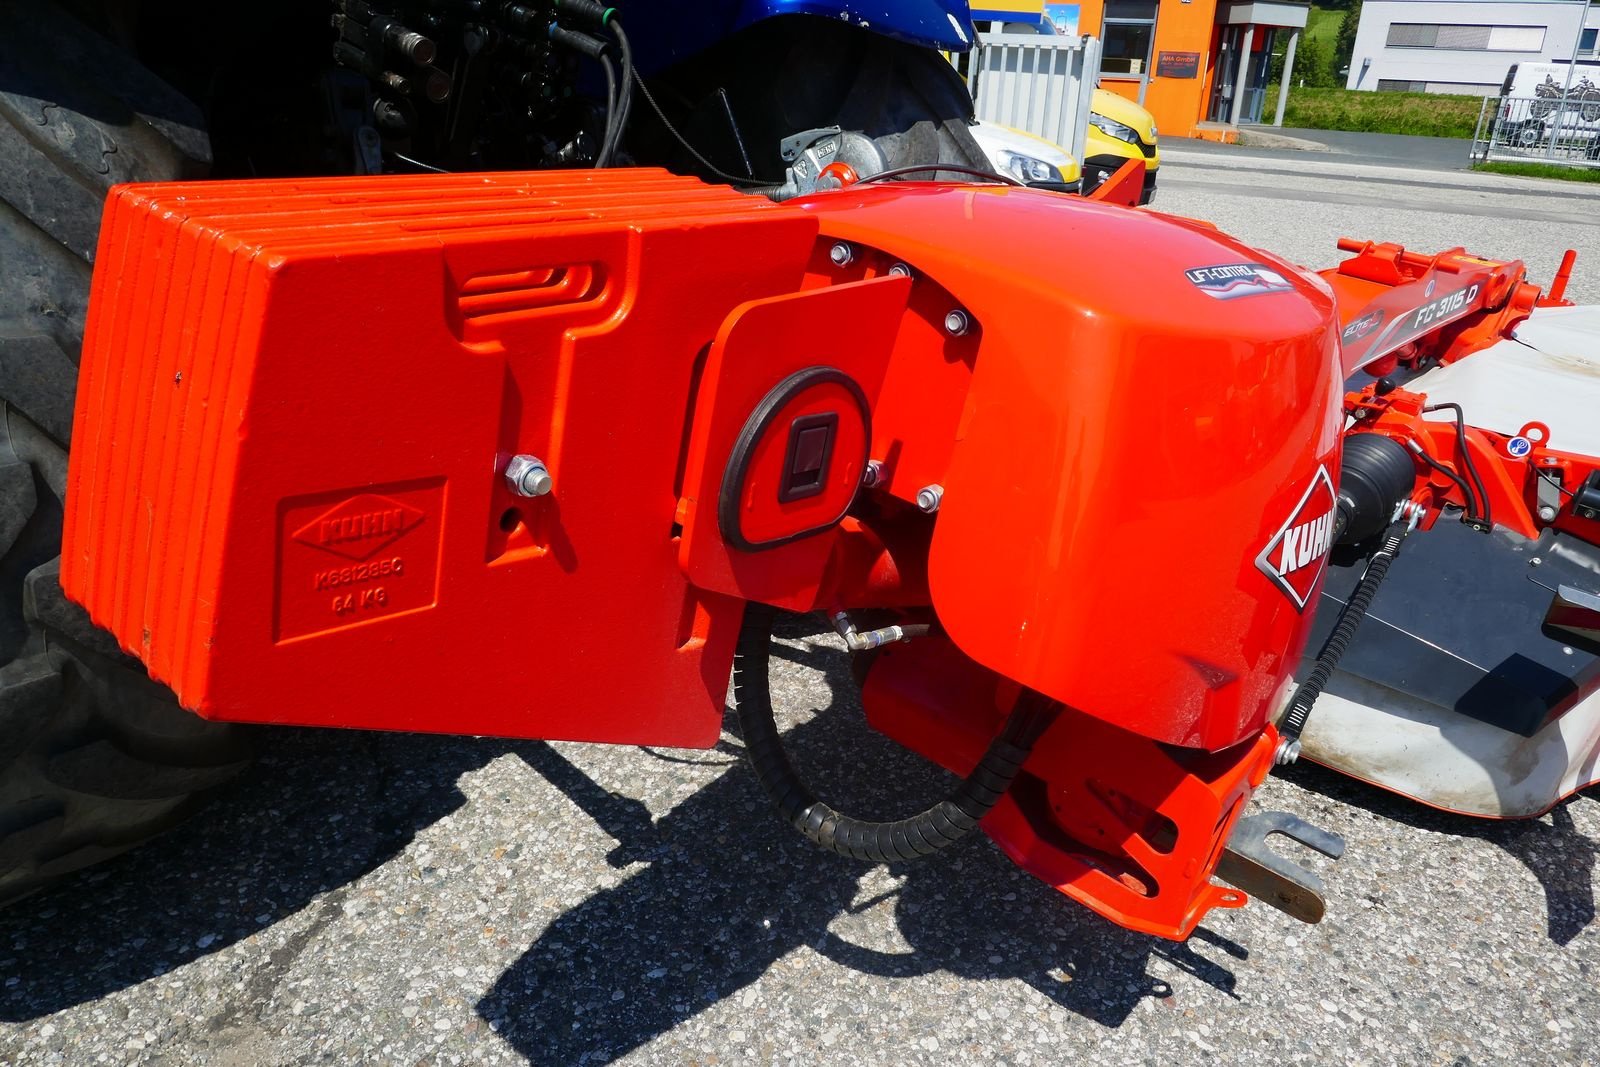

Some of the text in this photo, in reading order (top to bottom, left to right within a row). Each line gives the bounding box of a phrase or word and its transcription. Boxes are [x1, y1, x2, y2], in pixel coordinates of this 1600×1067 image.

[1414, 284, 1479, 329] FC 3115 D
[319, 508, 403, 544] KUHN
[1279, 506, 1336, 577] KUHN
